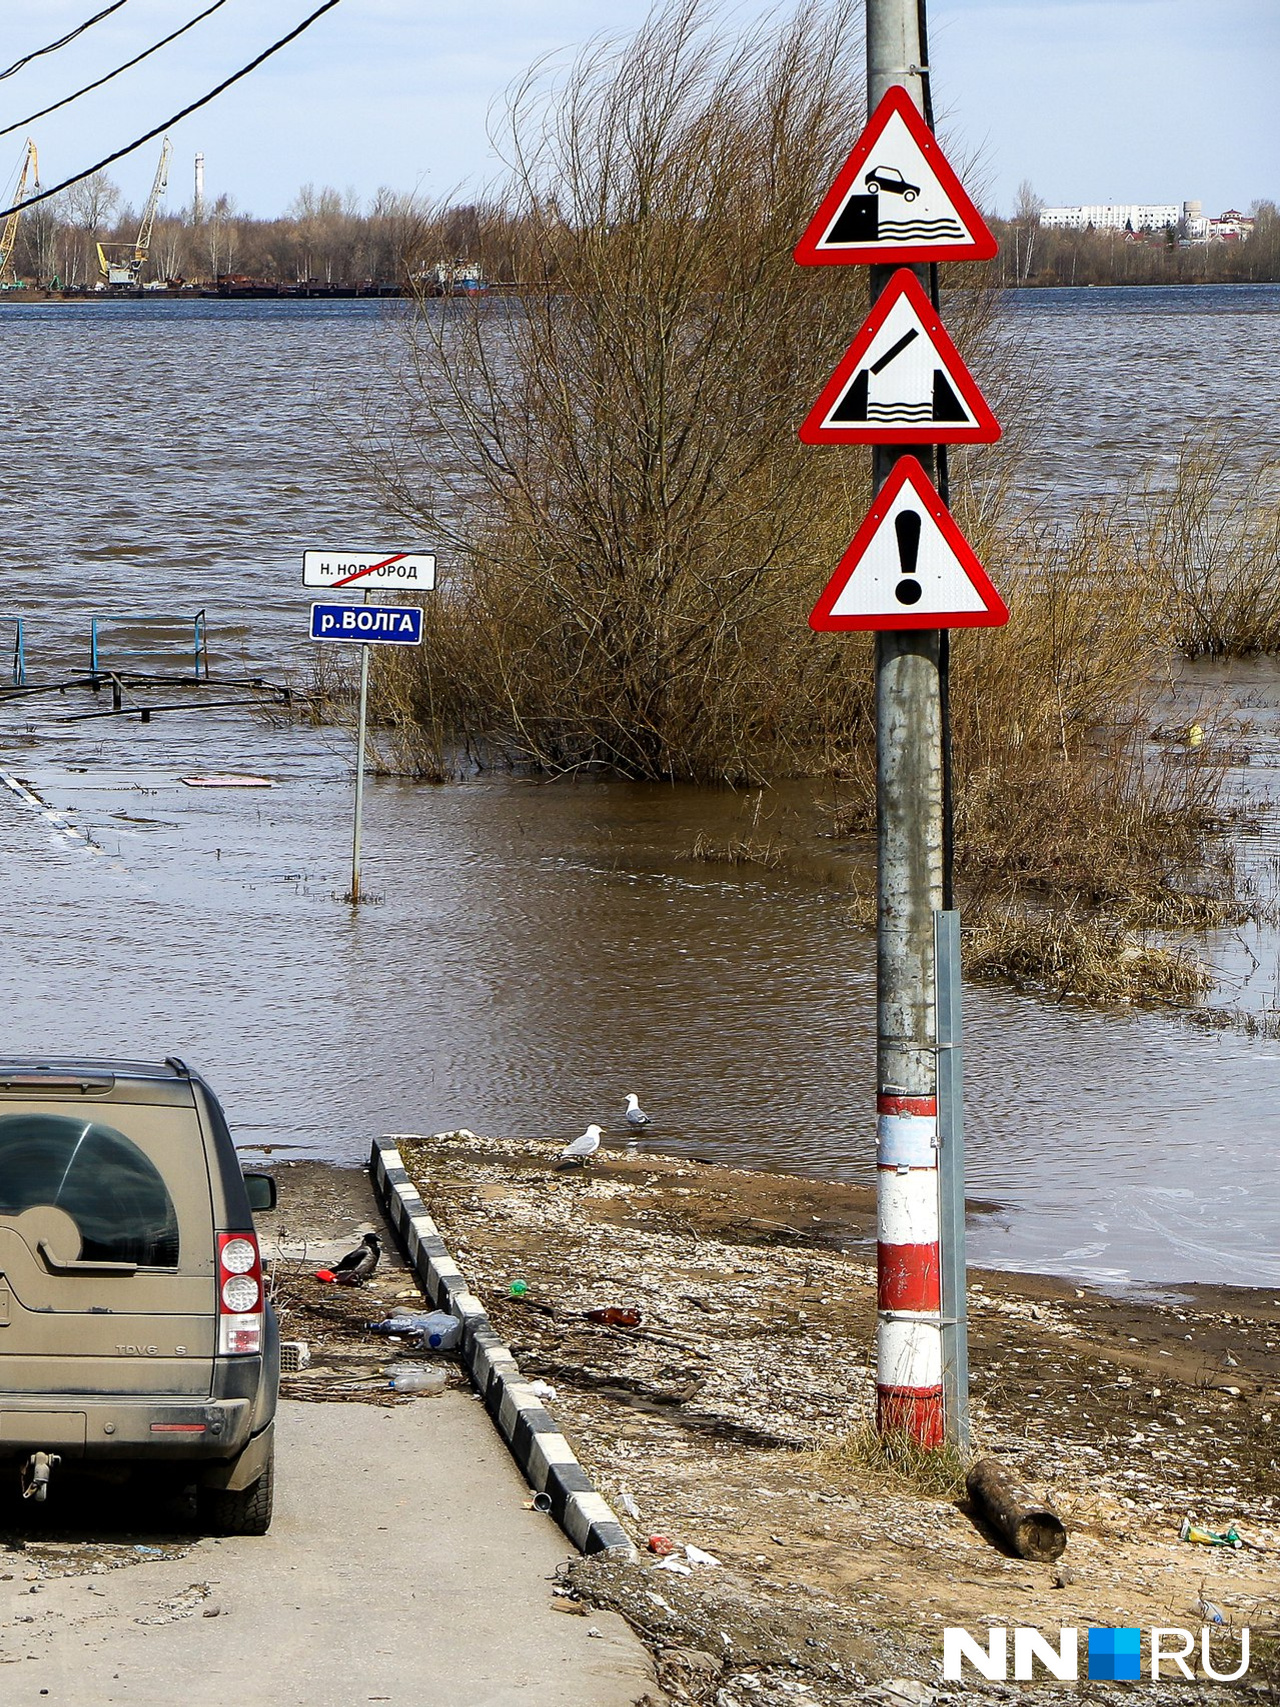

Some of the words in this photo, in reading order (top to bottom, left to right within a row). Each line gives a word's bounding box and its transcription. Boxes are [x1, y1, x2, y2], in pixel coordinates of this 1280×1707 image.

[320, 563, 334, 575] Н.
[115, 1344, 159, 1356] TDV6
[175, 1344, 187, 1356] S
